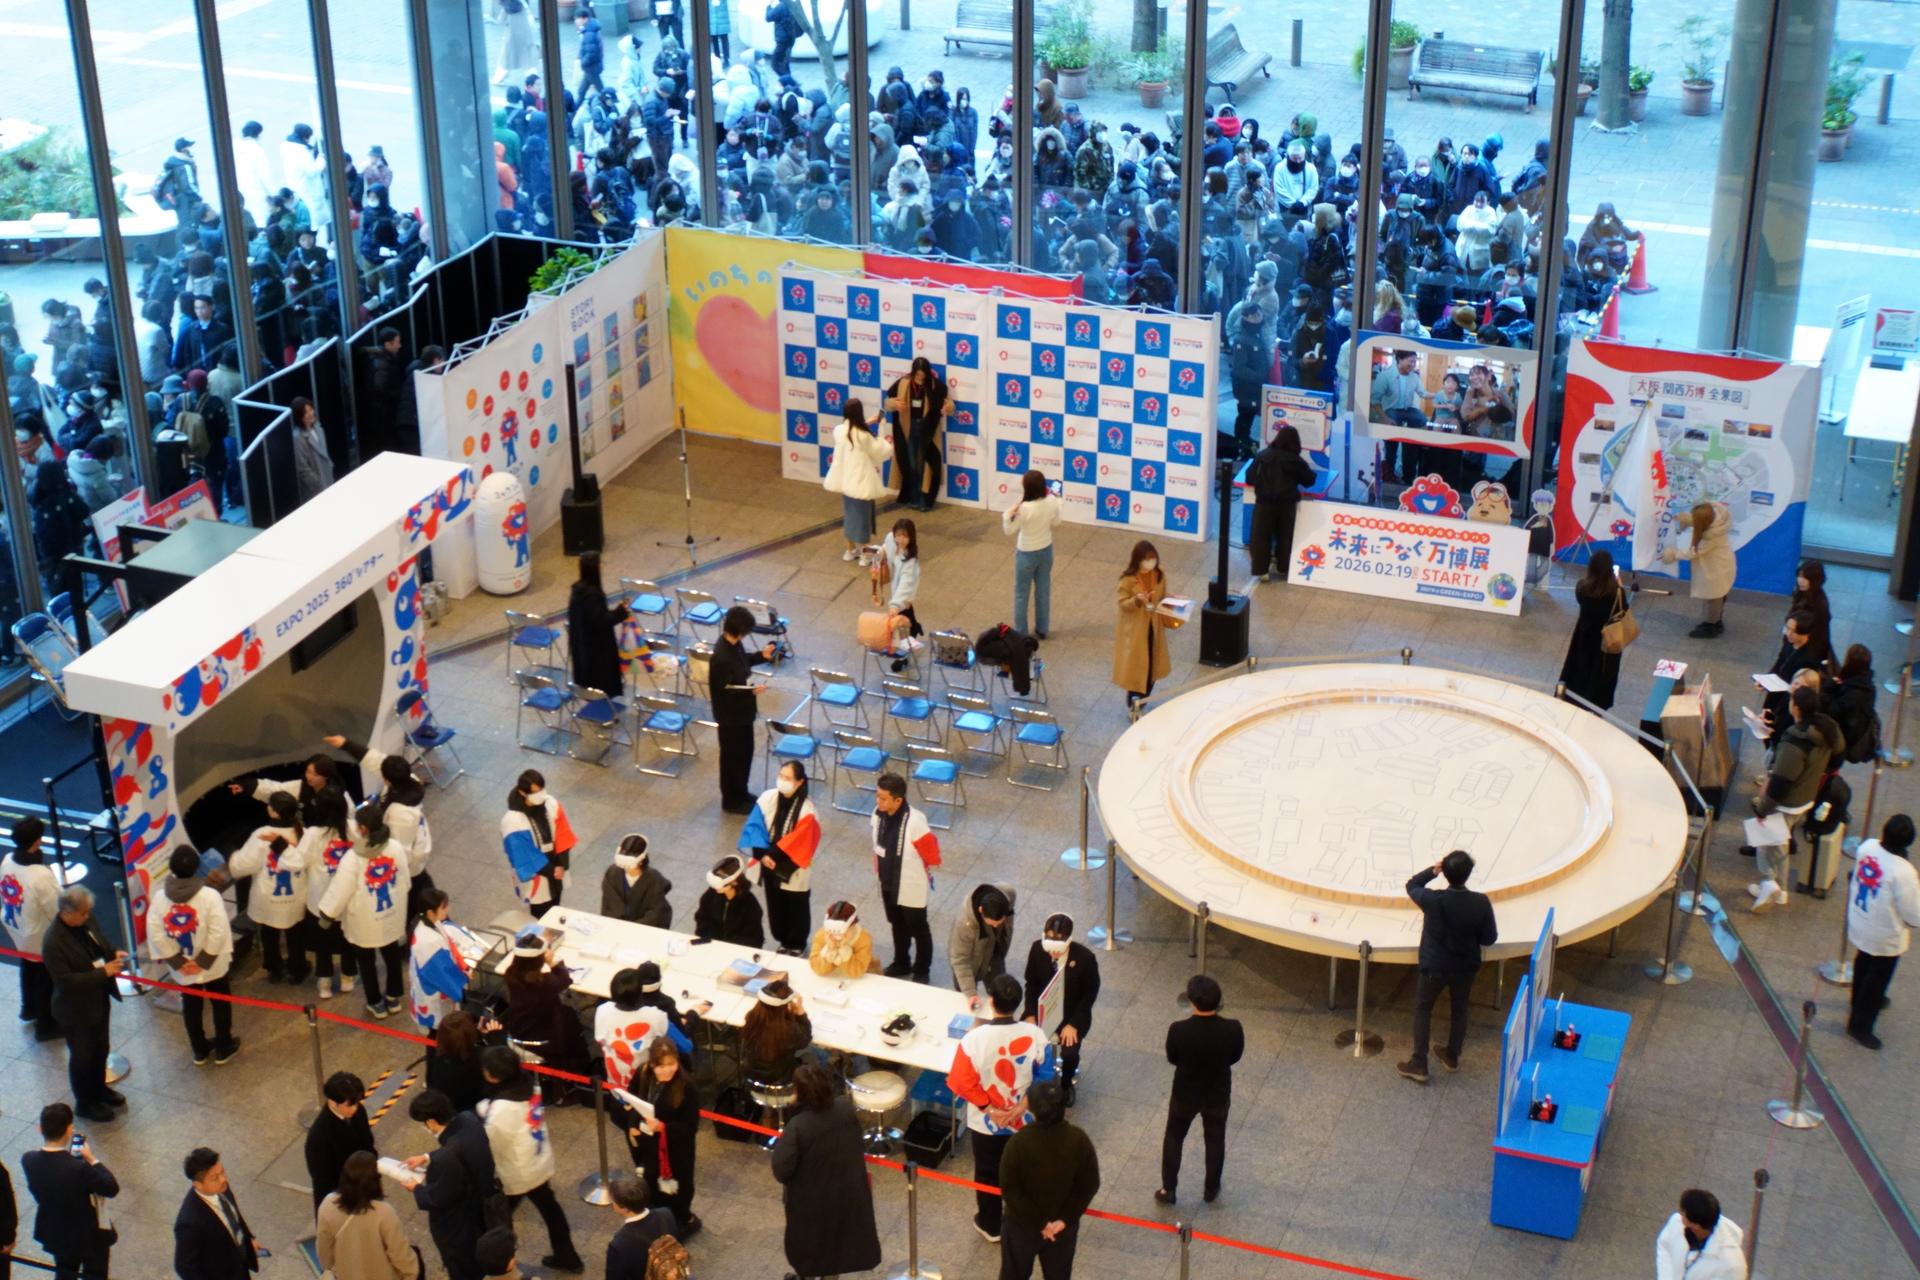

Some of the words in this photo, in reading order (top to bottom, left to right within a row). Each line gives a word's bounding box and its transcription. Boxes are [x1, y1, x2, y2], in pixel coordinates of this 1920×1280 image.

[571, 295, 594, 319] STORY
[571, 308, 595, 332] BOOK
[1708, 388, 1743, 404] 全景図
[1334, 556, 1412, 579] 2026.02.19
[1421, 568, 1479, 588] START!
[275, 609, 304, 638] EXPO
[306, 589, 330, 616] 2025
